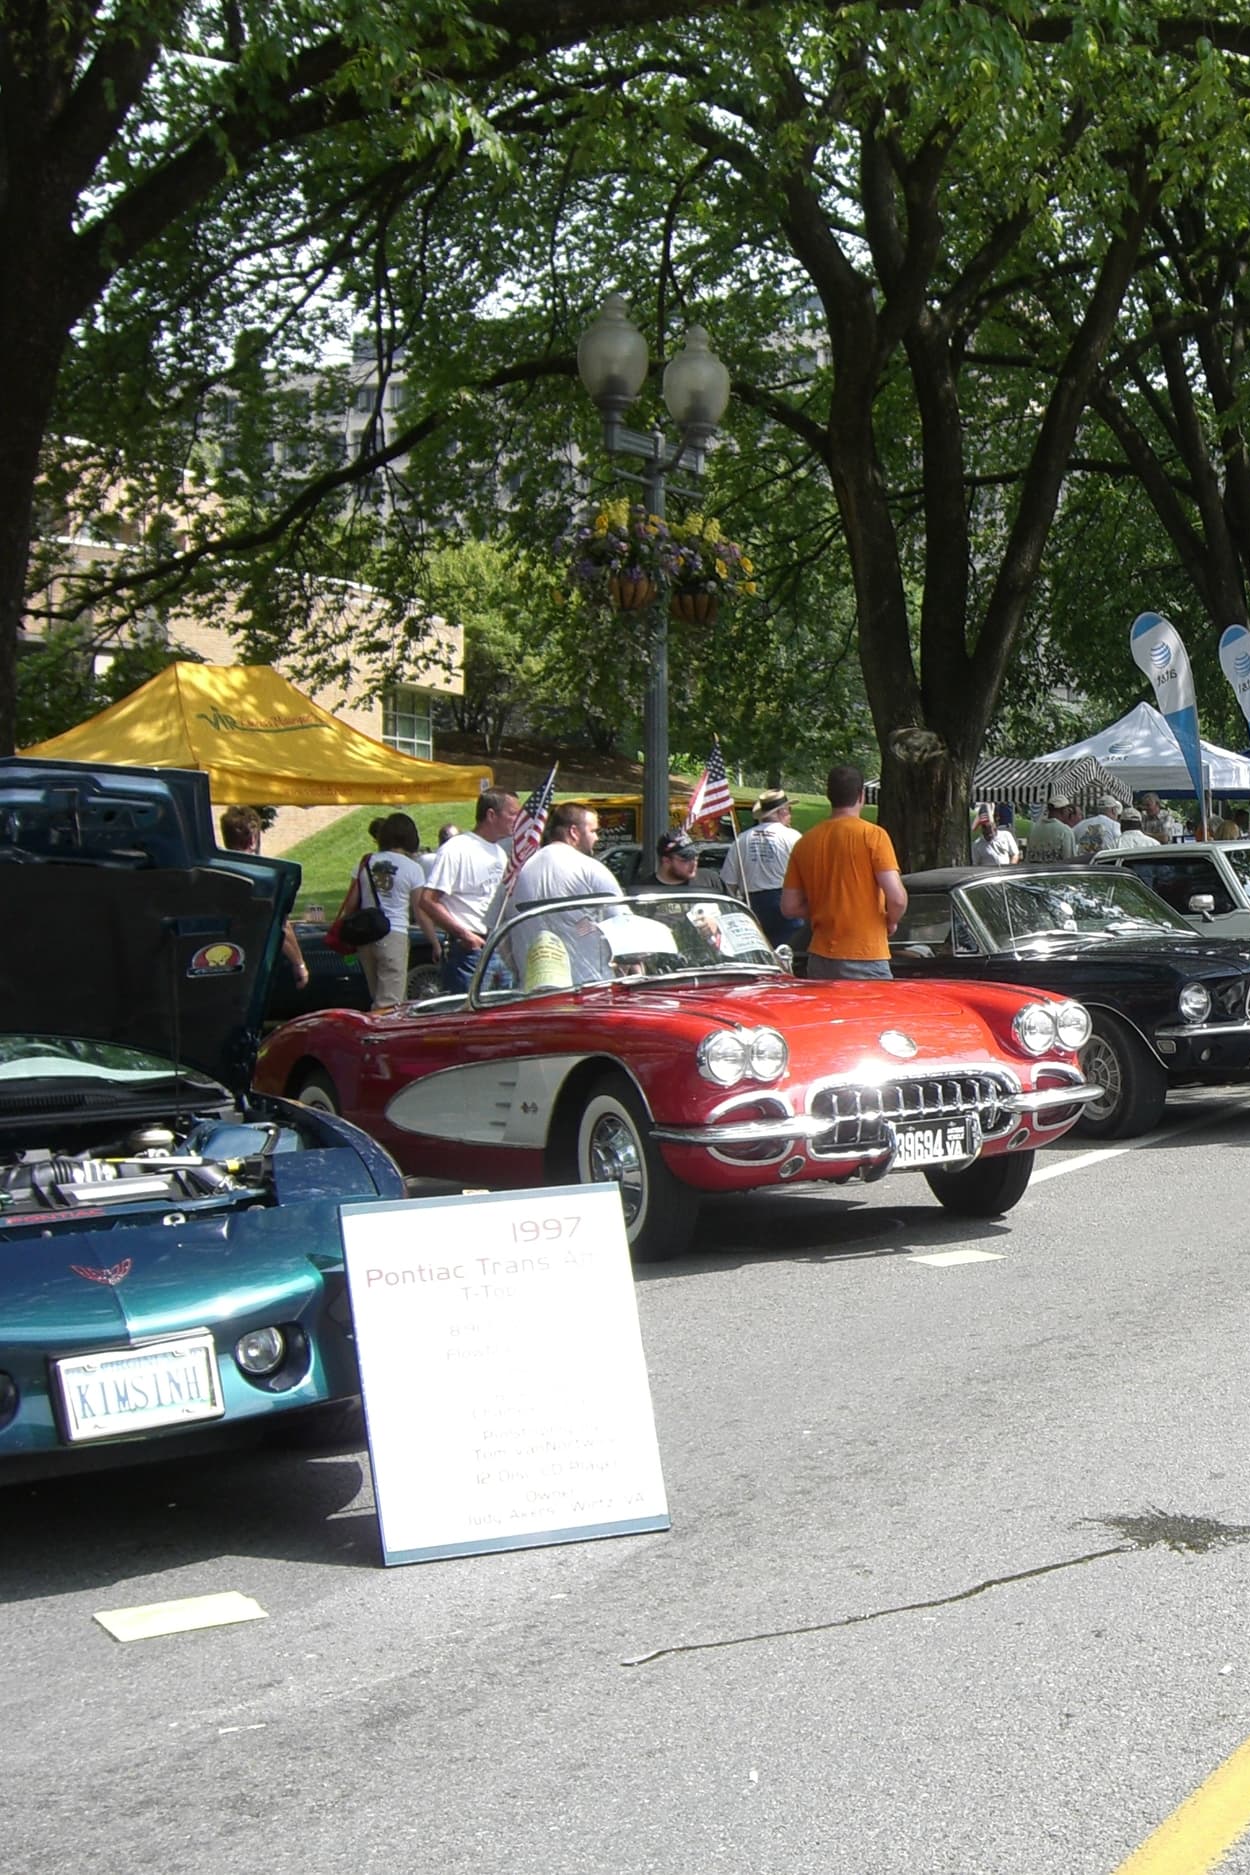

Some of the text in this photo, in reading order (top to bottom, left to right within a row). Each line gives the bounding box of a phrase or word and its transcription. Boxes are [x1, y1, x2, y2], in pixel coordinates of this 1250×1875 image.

[946, 1139, 963, 1156] VA
[511, 1216, 582, 1243] 1997
[366, 1263, 466, 1288] Pontiac
[475, 1256, 552, 1277] Trans
[77, 1366, 203, 1419] KIMSINH
